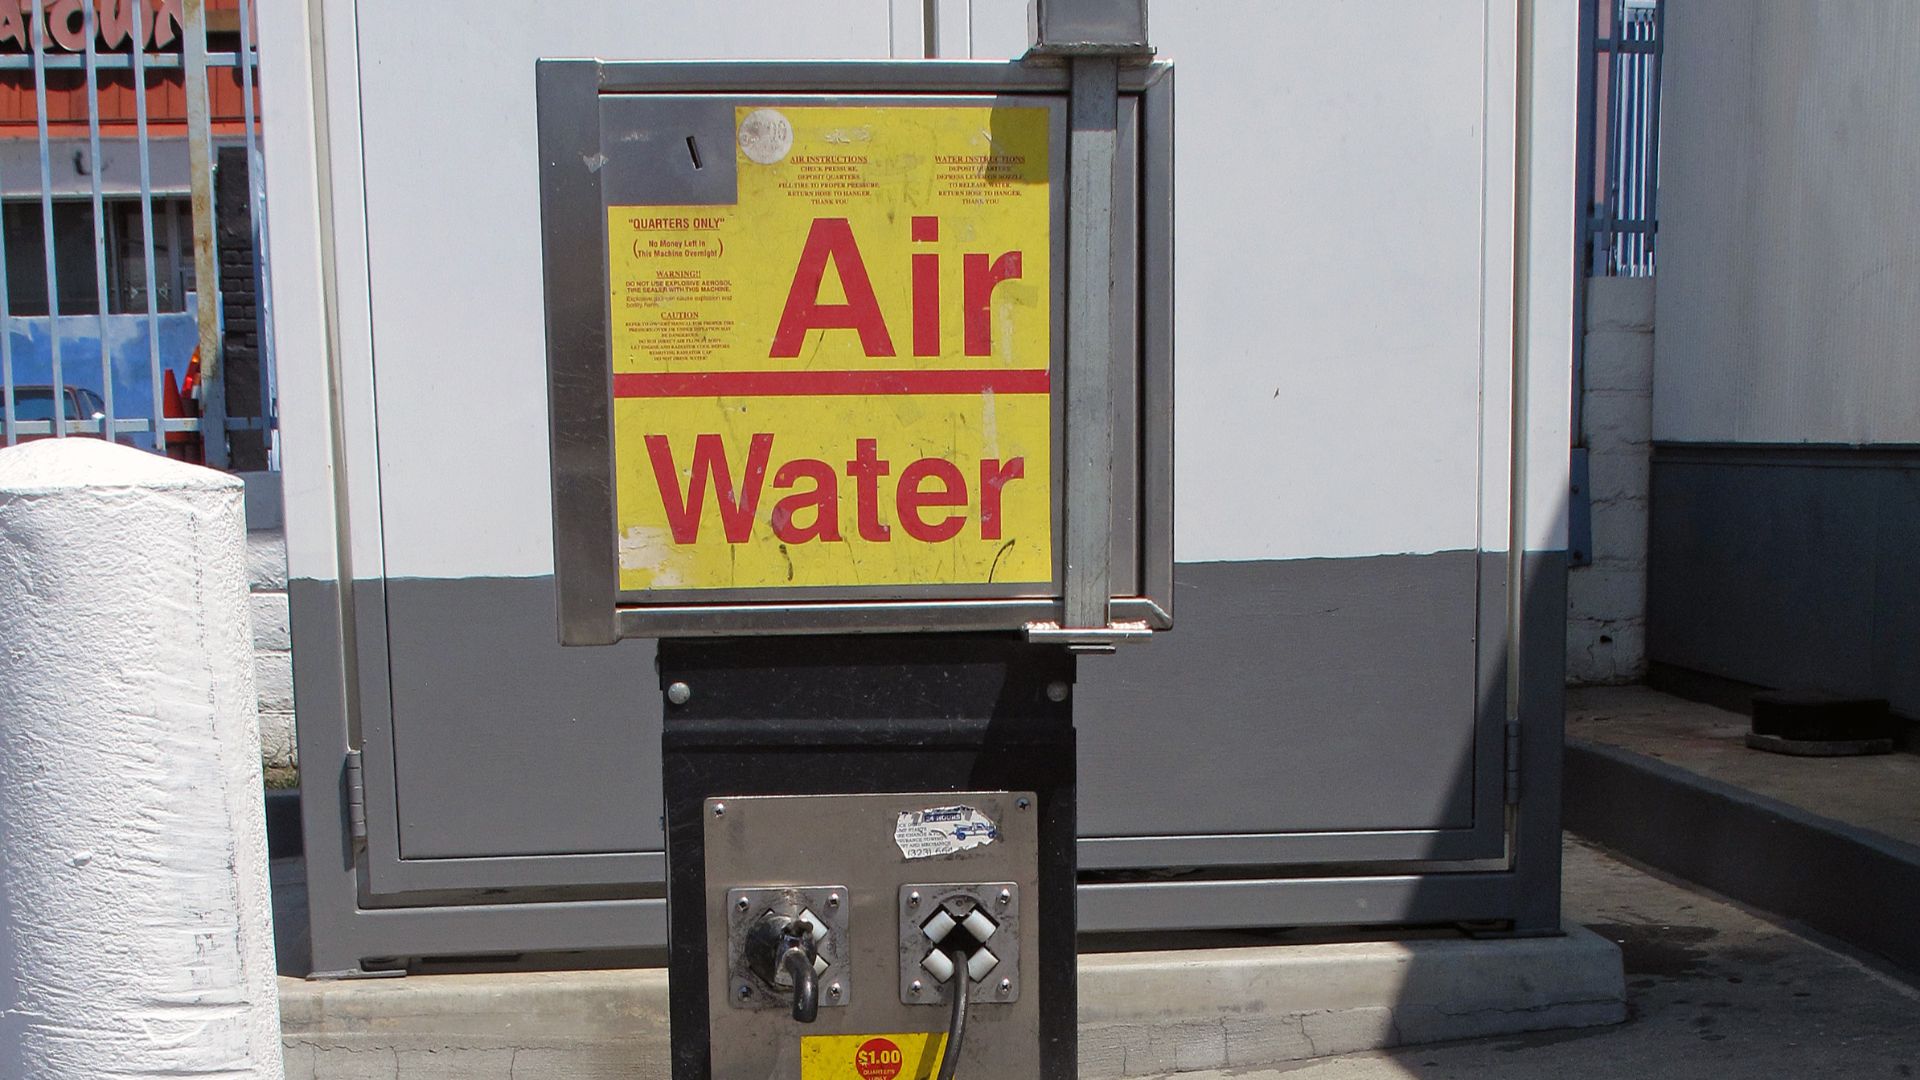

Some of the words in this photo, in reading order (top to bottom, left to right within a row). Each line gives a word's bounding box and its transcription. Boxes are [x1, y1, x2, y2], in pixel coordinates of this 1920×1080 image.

[790, 155, 804, 163] AIR
[806, 155, 868, 163] INSTRUCTIONS
[934, 155, 963, 164] WATER
[965, 155, 1025, 164] INSTRUCTIONS
[628, 218, 689, 230] "QUARTERS
[693, 218, 725, 229] ONLY"
[660, 240, 682, 248] Money
[656, 270, 701, 278] WARNING!!
[769, 216, 1022, 358] Air
[644, 433, 1024, 544] Water
[858, 1050, 900, 1065] $1.00
